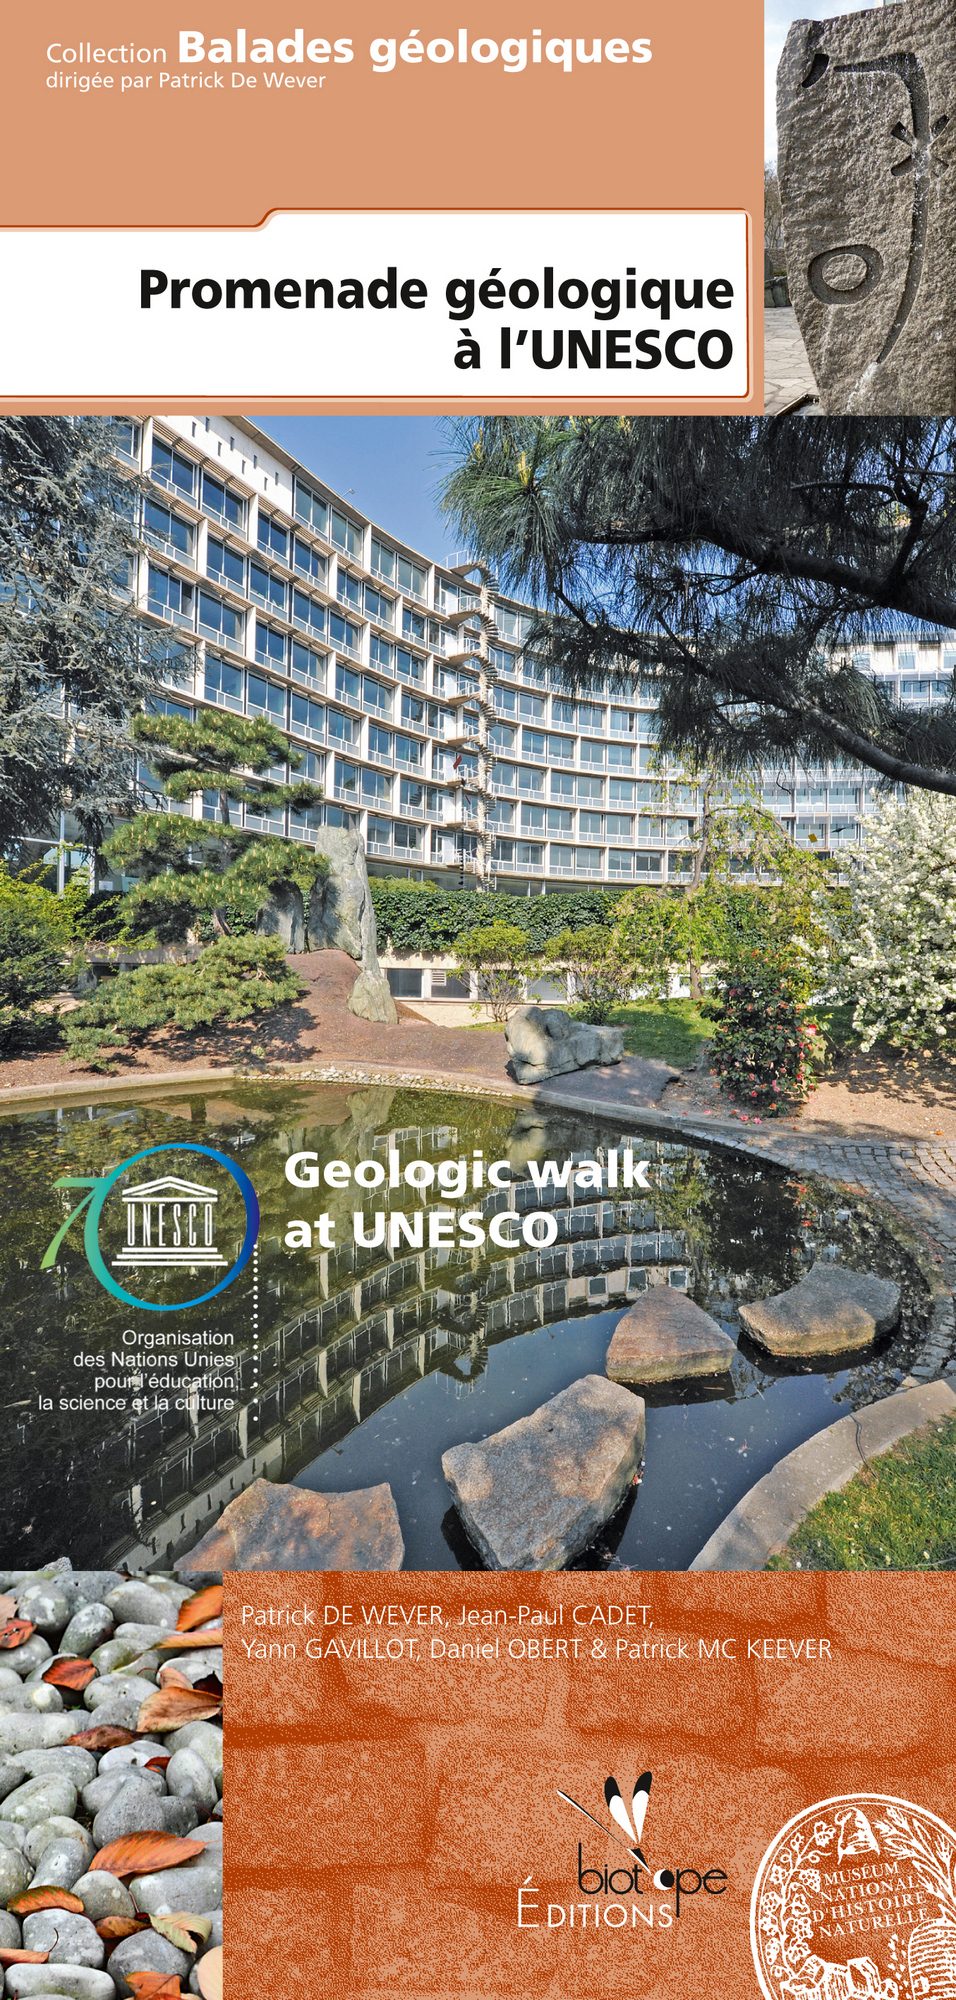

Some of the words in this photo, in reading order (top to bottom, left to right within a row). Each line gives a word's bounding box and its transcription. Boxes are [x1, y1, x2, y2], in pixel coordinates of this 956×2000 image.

[47, 43, 166, 63] Collection
[180, 29, 353, 63] Balades
[370, 29, 652, 72] géologiques
[47, 72, 113, 92] dirigée
[122, 76, 152, 92] par
[160, 72, 224, 87] Patrick
[232, 73, 256, 87] De
[263, 73, 326, 87] Wever
[141, 267, 427, 309] Promenade
[446, 267, 733, 320] géologique
[454, 328, 480, 369] à
[501, 327, 732, 369] l’UNESCO
[285, 1149, 511, 1198] Geologic
[527, 1149, 651, 1188] walk
[126, 1203, 213, 1248] UNESCO
[285, 1213, 335, 1247] at
[354, 1210, 559, 1248] UNESCO
[123, 1330, 233, 1348] Organisation
[74, 1352, 104, 1366] des
[112, 1351, 177, 1366] Nations
[185, 1352, 233, 1366] Unies
[96, 1376, 134, 1391] pour
[39, 1395, 53, 1410] la
[59, 1395, 127, 1410] science
[132, 1396, 149, 1410] et
[155, 1396, 168, 1409] la
[175, 1395, 235, 1410] culture
[243, 1604, 314, 1625] Patrick
[325, 1606, 352, 1624] DE
[362, 1606, 448, 1627] WEVER,
[459, 1605, 562, 1625] Jean-Paul
[573, 1606, 652, 1628] CADET,
[242, 1639, 295, 1658] Yann
[306, 1639, 420, 1661] GAVILLOT,
[432, 1638, 498, 1658] Daniel
[509, 1639, 582, 1658] OBERT
[592, 1639, 607, 1658] &
[617, 1638, 688, 1658] Patrick
[700, 1639, 736, 1658] MC
[748, 1639, 831, 1658] KEEVER
[824, 1862, 899, 1885] MUSÉUM
[517, 1875, 674, 1928] ÉDITIONS
[820, 1877, 919, 1903] NATIONAL
[819, 1908, 929, 1938] NATURELLE
